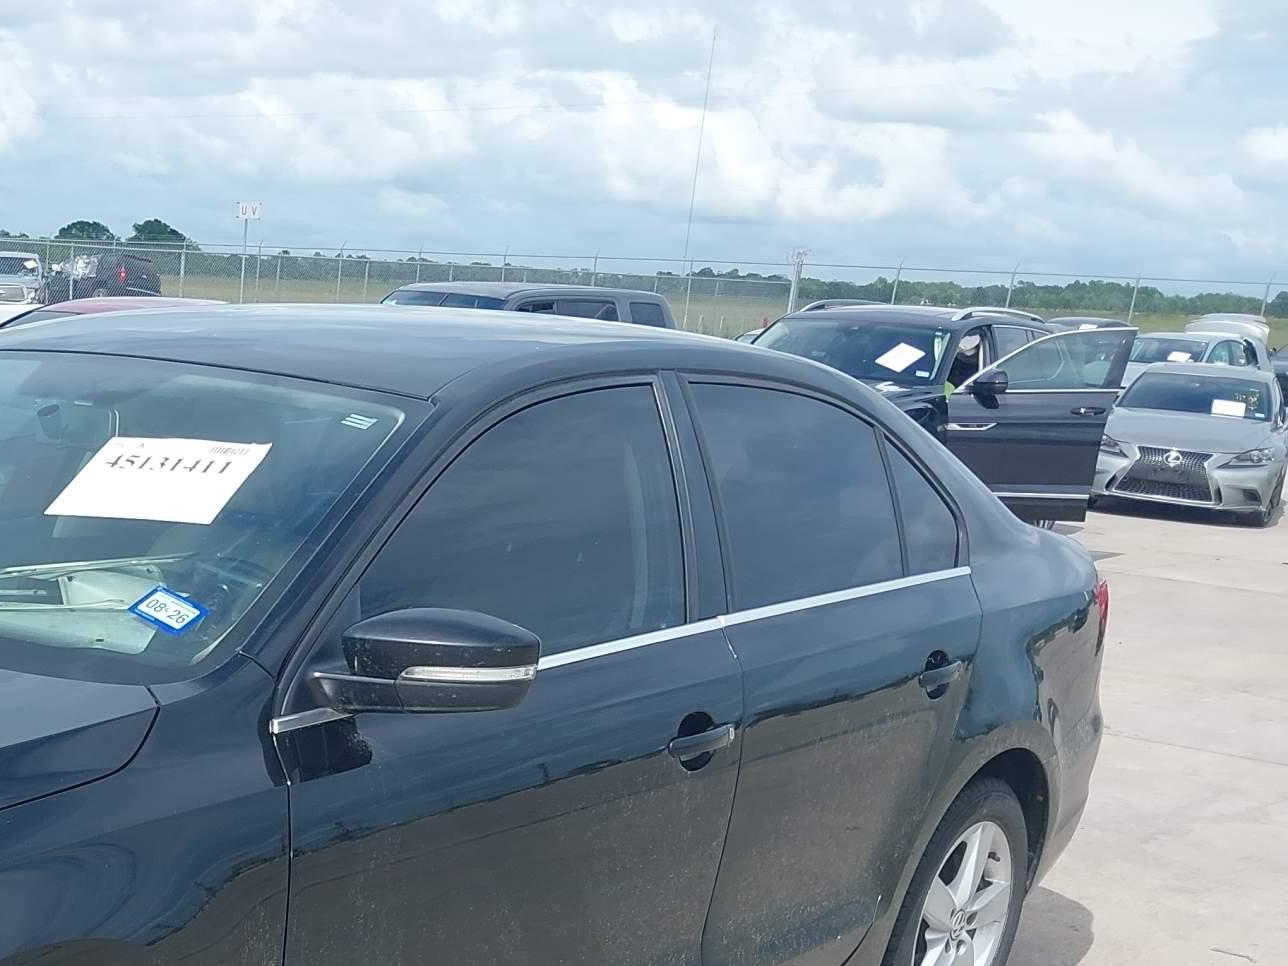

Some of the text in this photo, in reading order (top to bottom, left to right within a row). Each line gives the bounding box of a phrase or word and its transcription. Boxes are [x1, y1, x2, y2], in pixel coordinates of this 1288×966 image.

[105, 453, 233, 475] 45131411
[145, 599, 190, 624] 08 26
